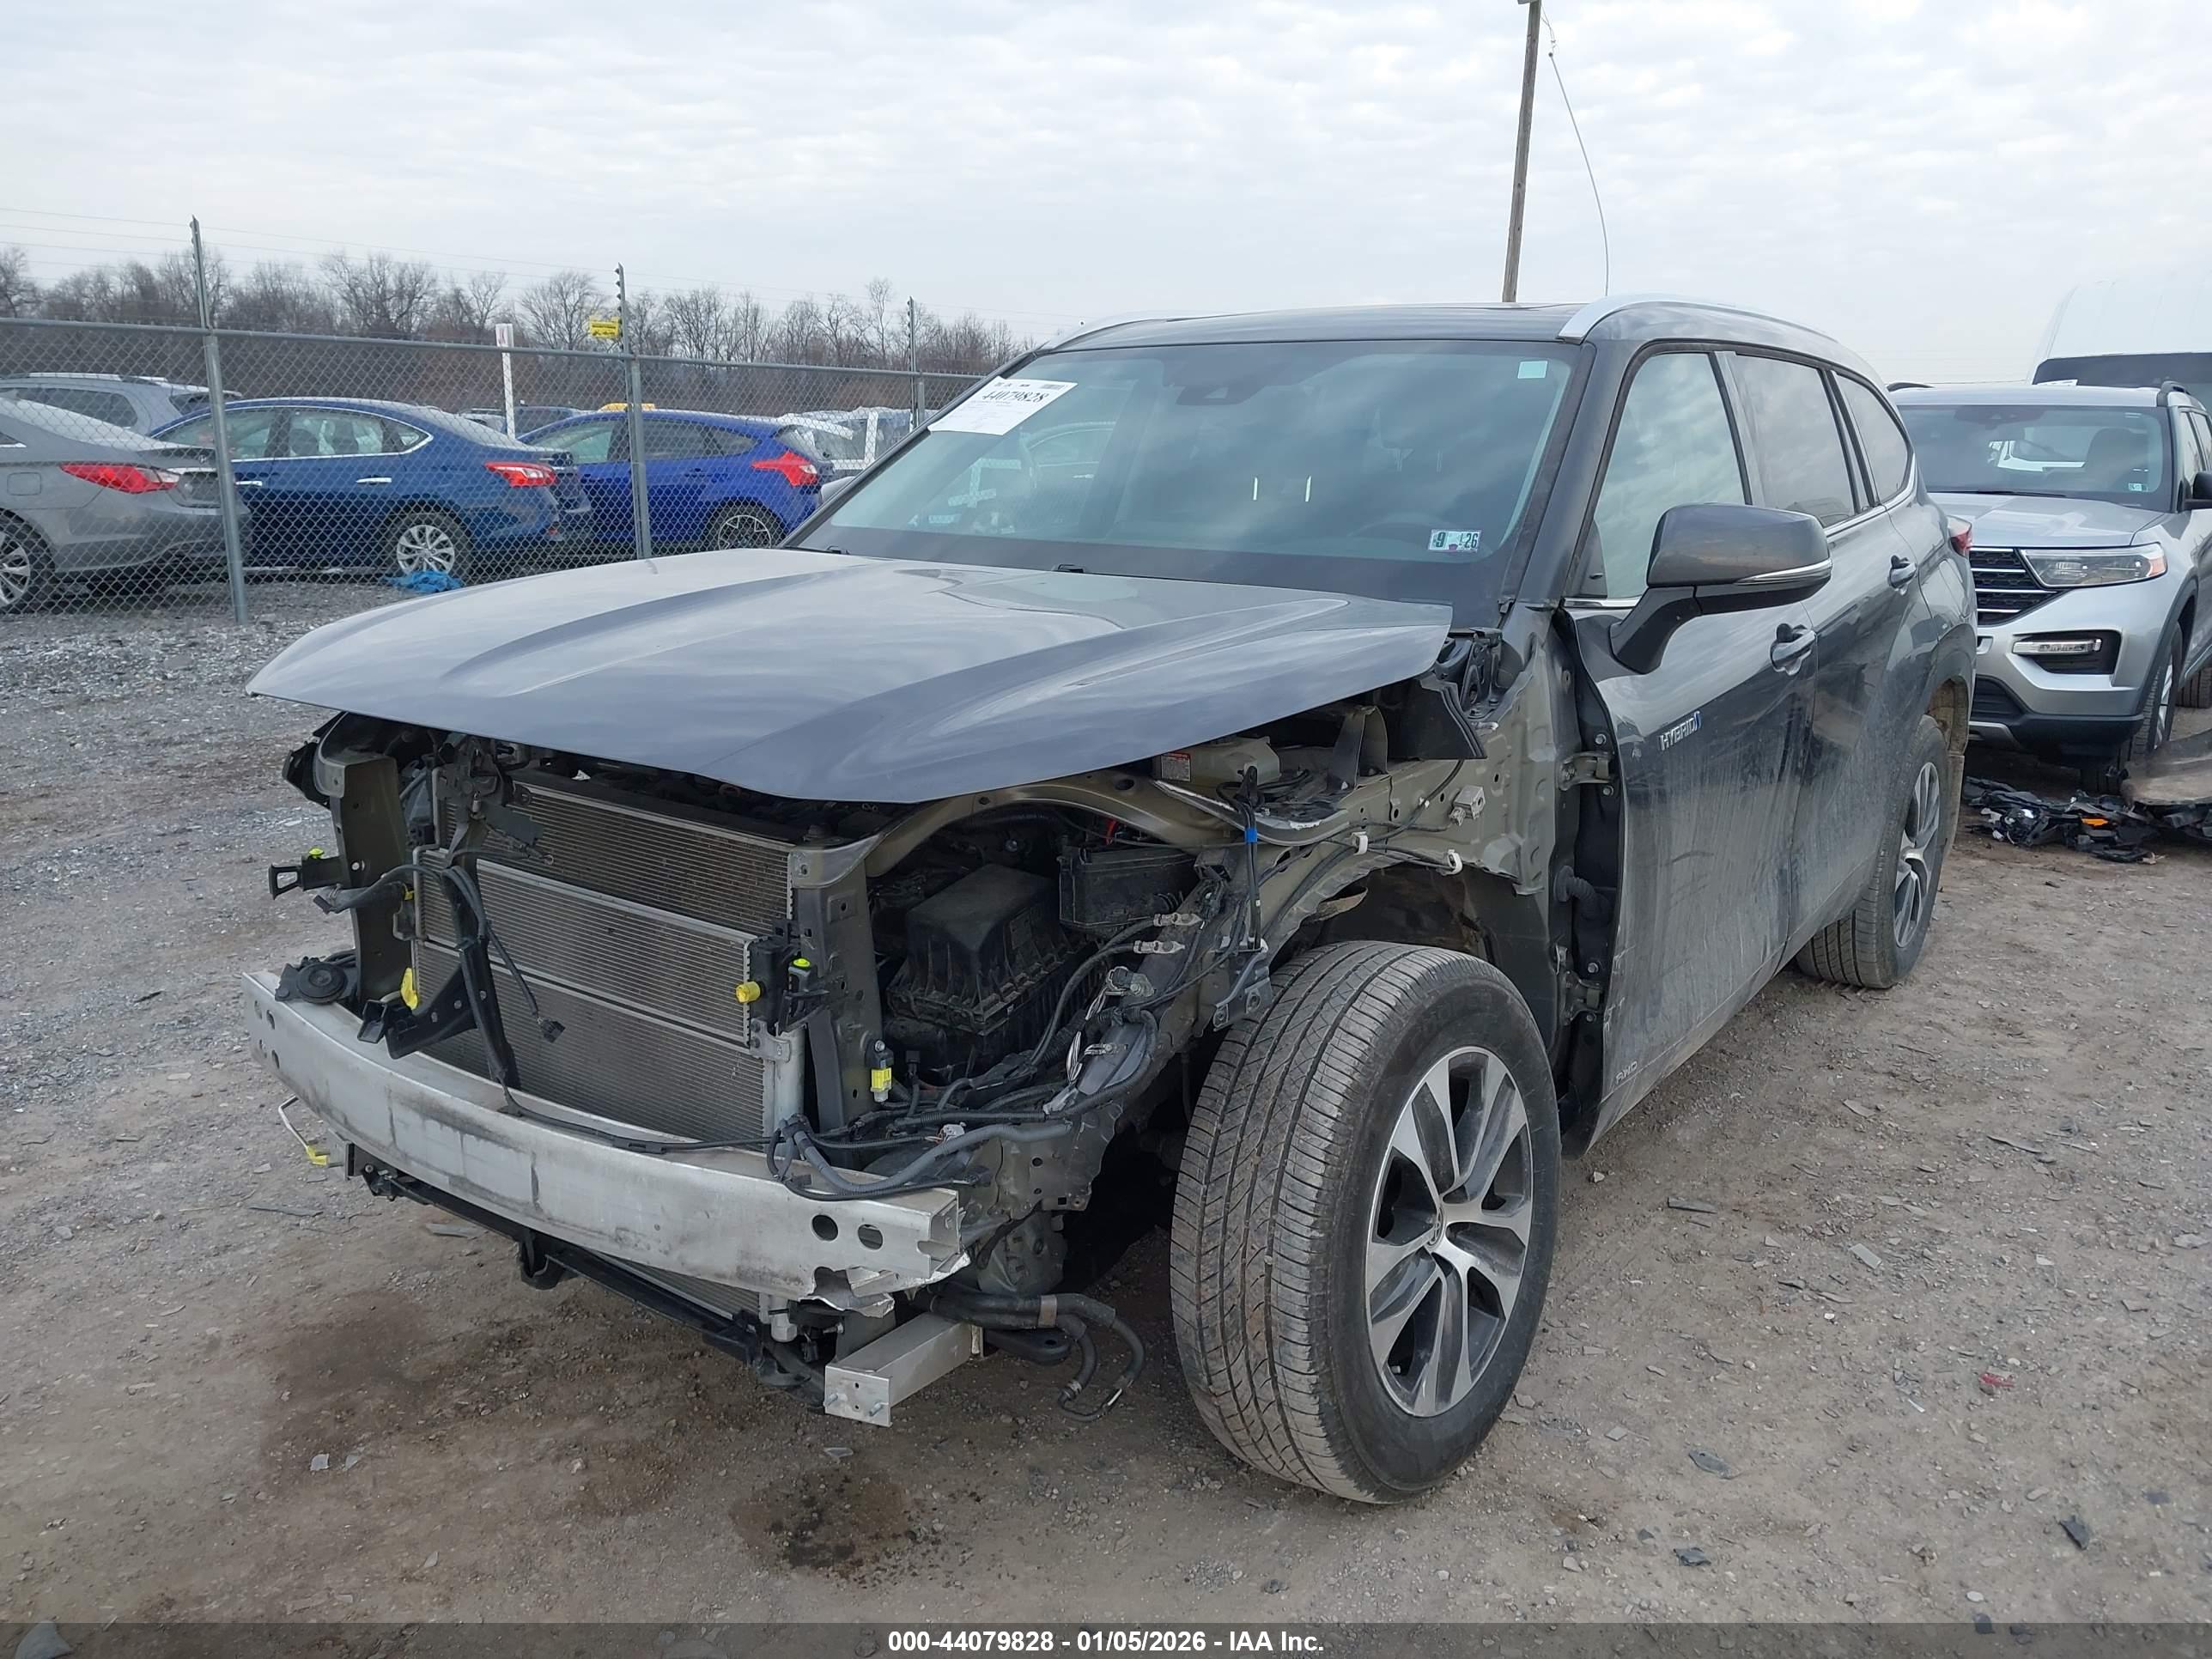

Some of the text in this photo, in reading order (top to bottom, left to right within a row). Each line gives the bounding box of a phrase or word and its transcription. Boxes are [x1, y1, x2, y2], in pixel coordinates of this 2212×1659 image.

[981, 391, 1049, 403] 44079828
[1435, 532, 1446, 548] 9
[1658, 716, 1698, 751] HYBRID
[1615, 1060, 1638, 1085] AWD
